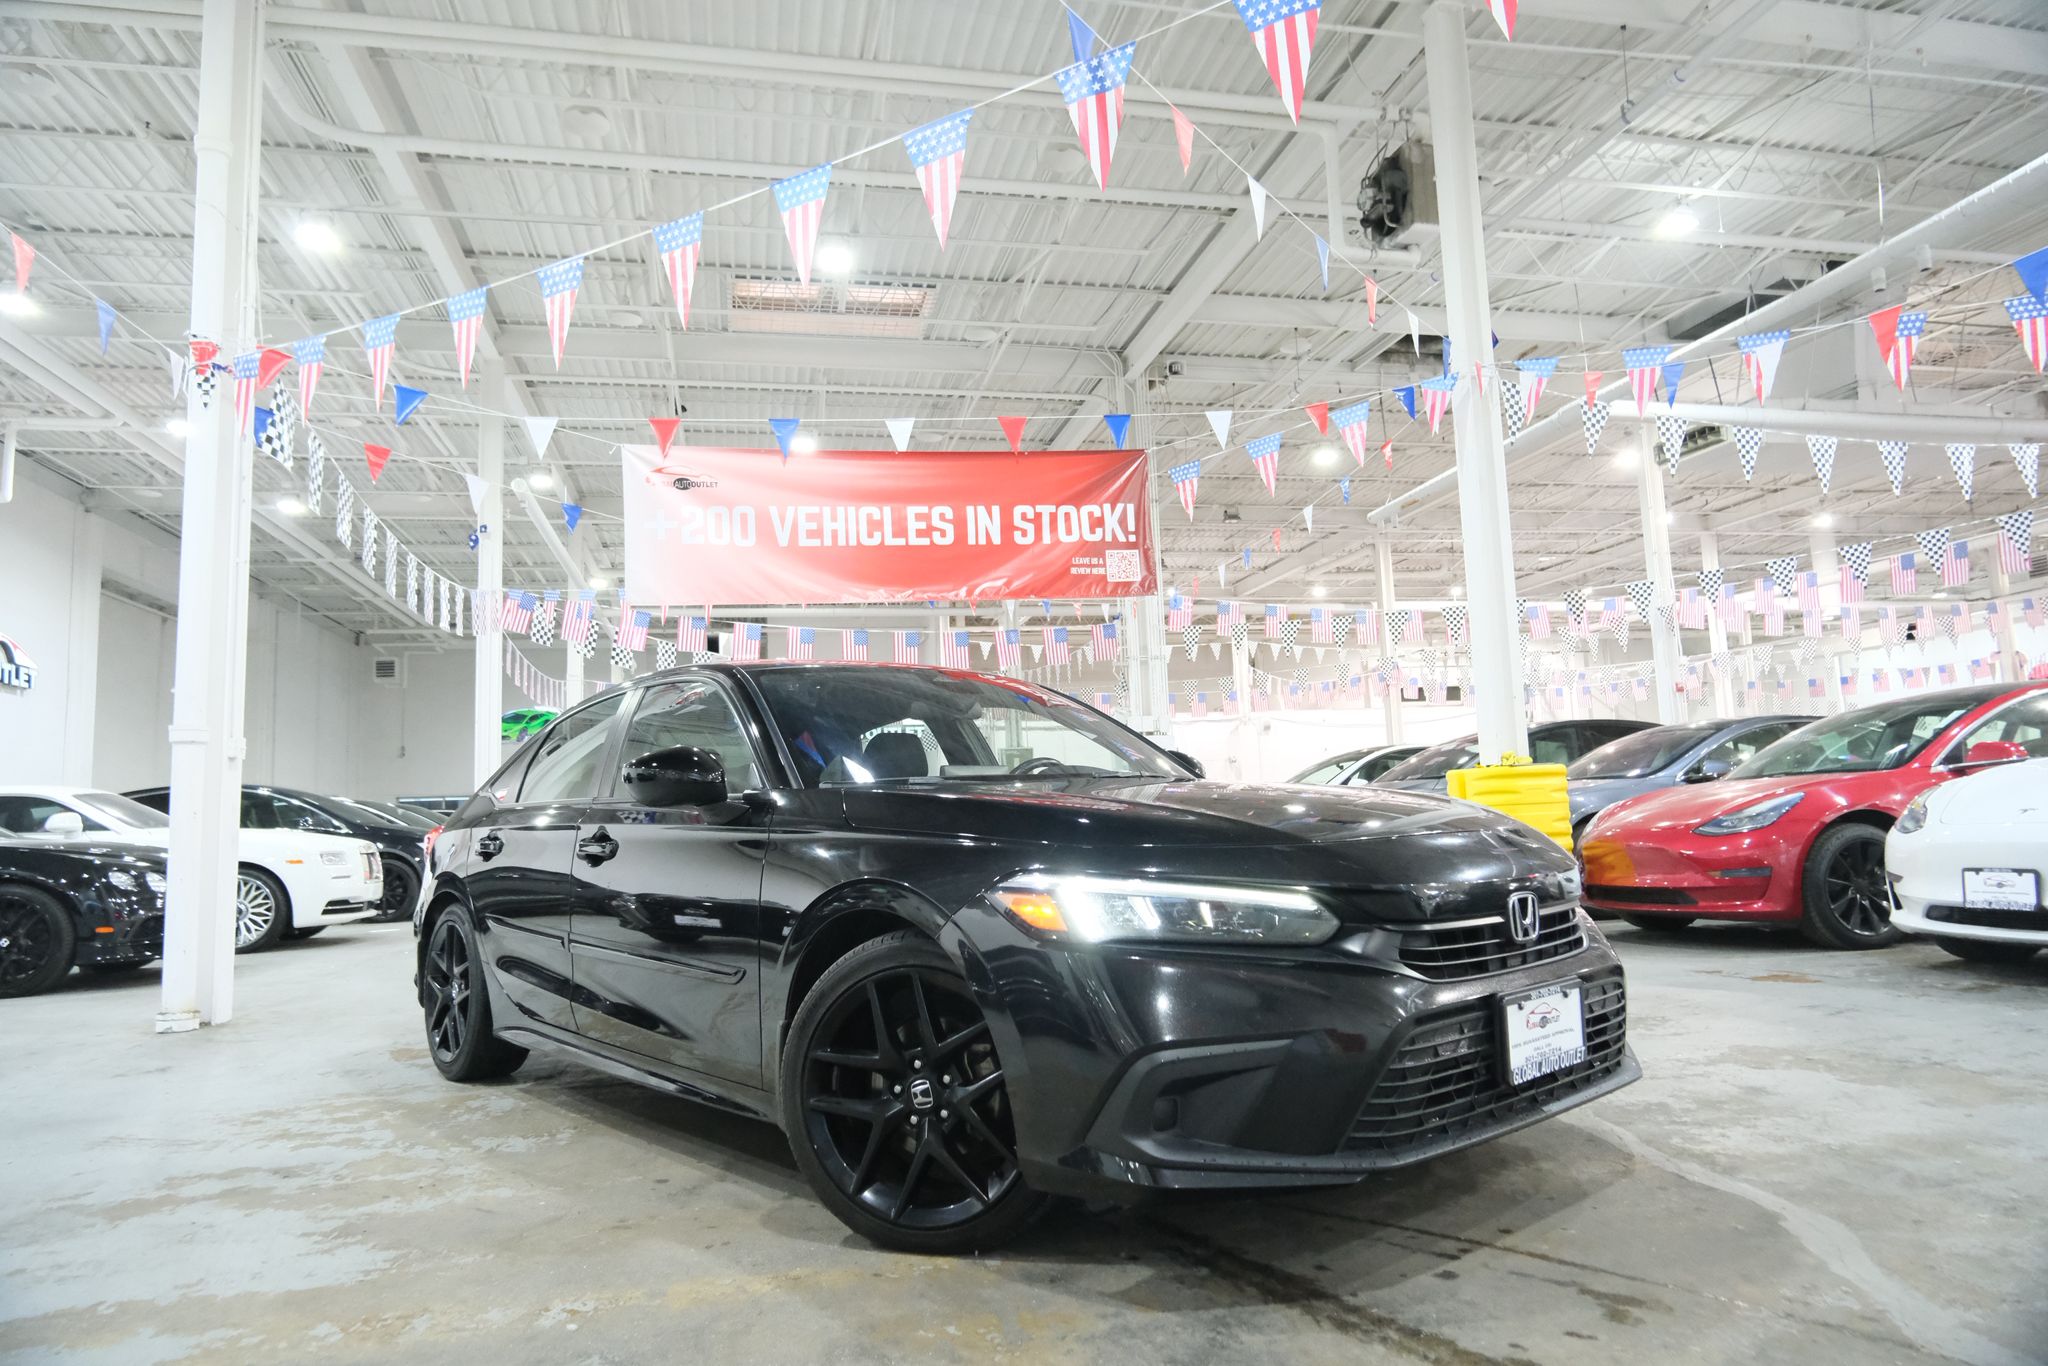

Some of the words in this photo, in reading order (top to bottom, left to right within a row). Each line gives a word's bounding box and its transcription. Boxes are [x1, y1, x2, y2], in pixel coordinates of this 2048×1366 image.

[644, 504, 756, 547] +200
[768, 505, 955, 547] VEHICLES
[966, 505, 1001, 545] IN
[1013, 502, 1137, 545] STOCK!
[0, 660, 38, 689] TLET
[1513, 1061, 1542, 1085] GLOBAL
[1541, 1056, 1560, 1075] AUTO
[1560, 1046, 1586, 1068] OUTLET
